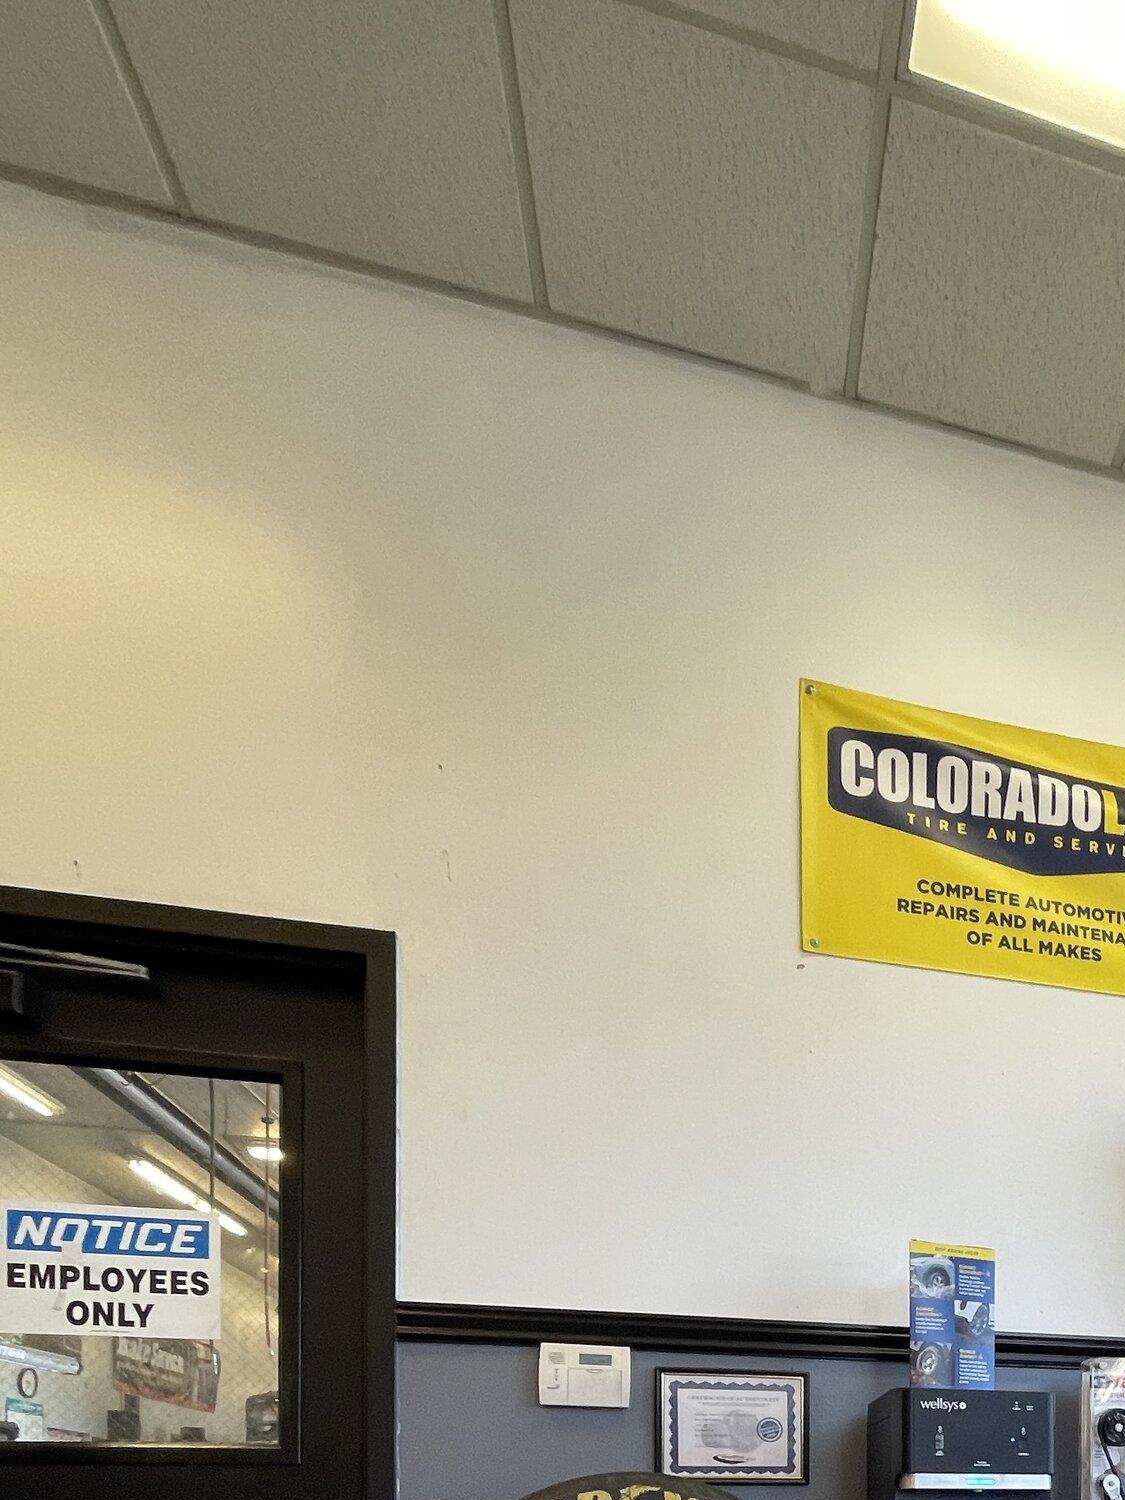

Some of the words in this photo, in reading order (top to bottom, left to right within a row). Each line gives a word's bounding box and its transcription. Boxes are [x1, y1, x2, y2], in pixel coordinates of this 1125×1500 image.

[907, 812, 967, 836] TIRE
[986, 827, 1036, 846] AND
[916, 879, 1020, 907] COMPLETE
[896, 898, 980, 924] REPAIRS
[985, 909, 1027, 929] AND
[966, 930, 993, 948] OF
[998, 935, 1034, 955] ALL
[1038, 940, 1103, 962] MAKES
[14, 1215, 203, 1254] NOTICE
[7, 1263, 210, 1296] EMPLOYEES
[66, 1300, 155, 1328] ONLY
[920, 1397, 959, 1413] wellsys
